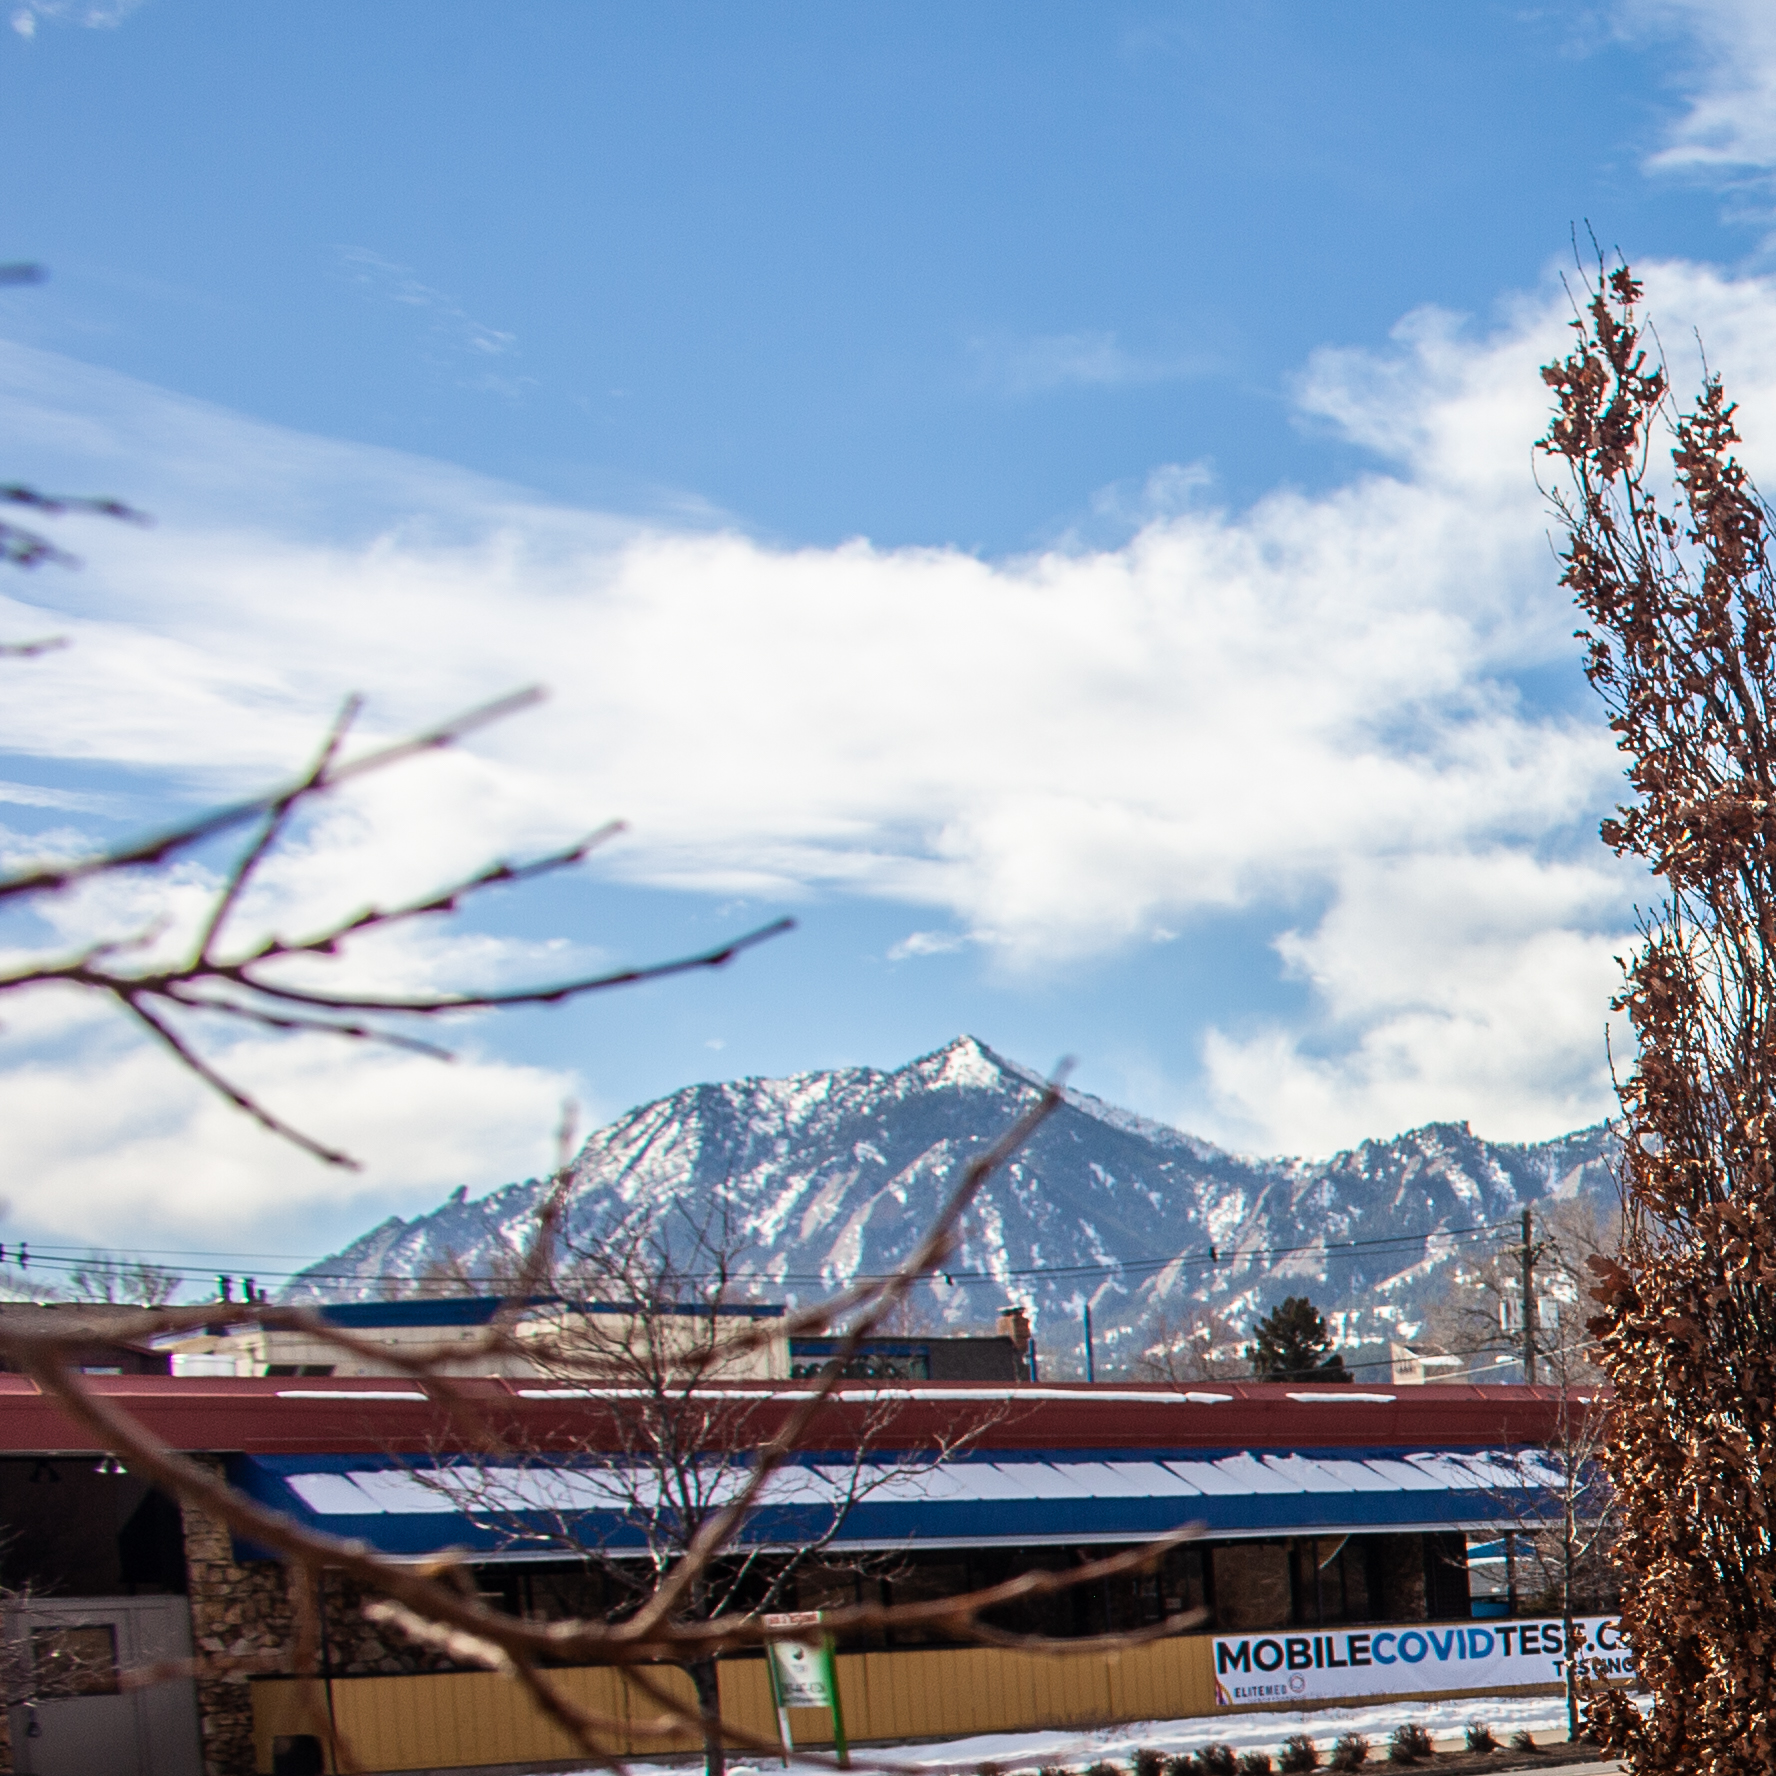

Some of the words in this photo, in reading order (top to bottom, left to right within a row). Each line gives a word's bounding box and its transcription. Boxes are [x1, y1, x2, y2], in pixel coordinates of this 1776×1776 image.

[1217, 1620, 1630, 1675] MOBILECOVIDTES.C
[1552, 1657, 1635, 1677] TSNG
[1234, 1684, 1288, 1698] ELITEMED
